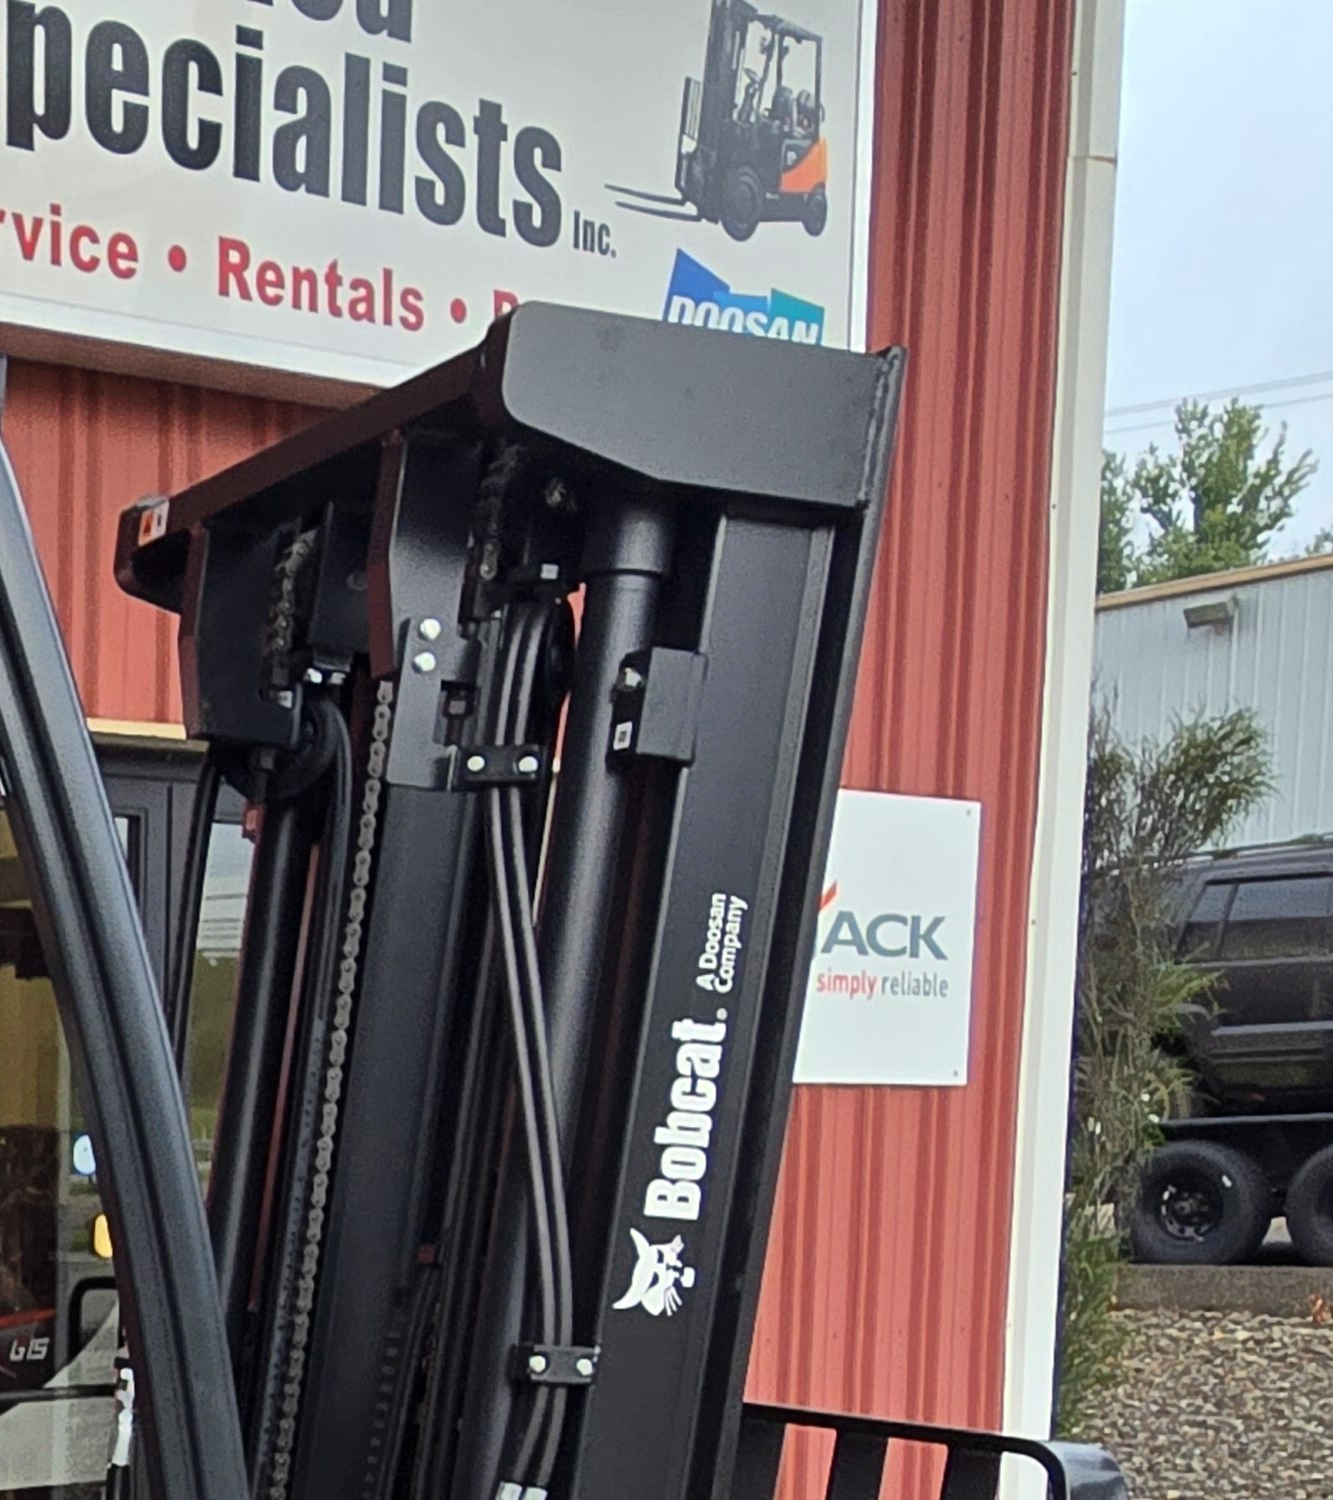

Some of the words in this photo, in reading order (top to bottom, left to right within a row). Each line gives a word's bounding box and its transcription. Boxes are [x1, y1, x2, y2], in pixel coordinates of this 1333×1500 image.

[572, 209, 618, 259] Inc.
[217, 234, 425, 332] Rentals
[698, 892, 727, 970] Doosan
[714, 895, 749, 994] Company
[816, 966, 877, 1001] simply
[880, 970, 949, 999] reliable
[643, 1017, 727, 1221] Bobcat
